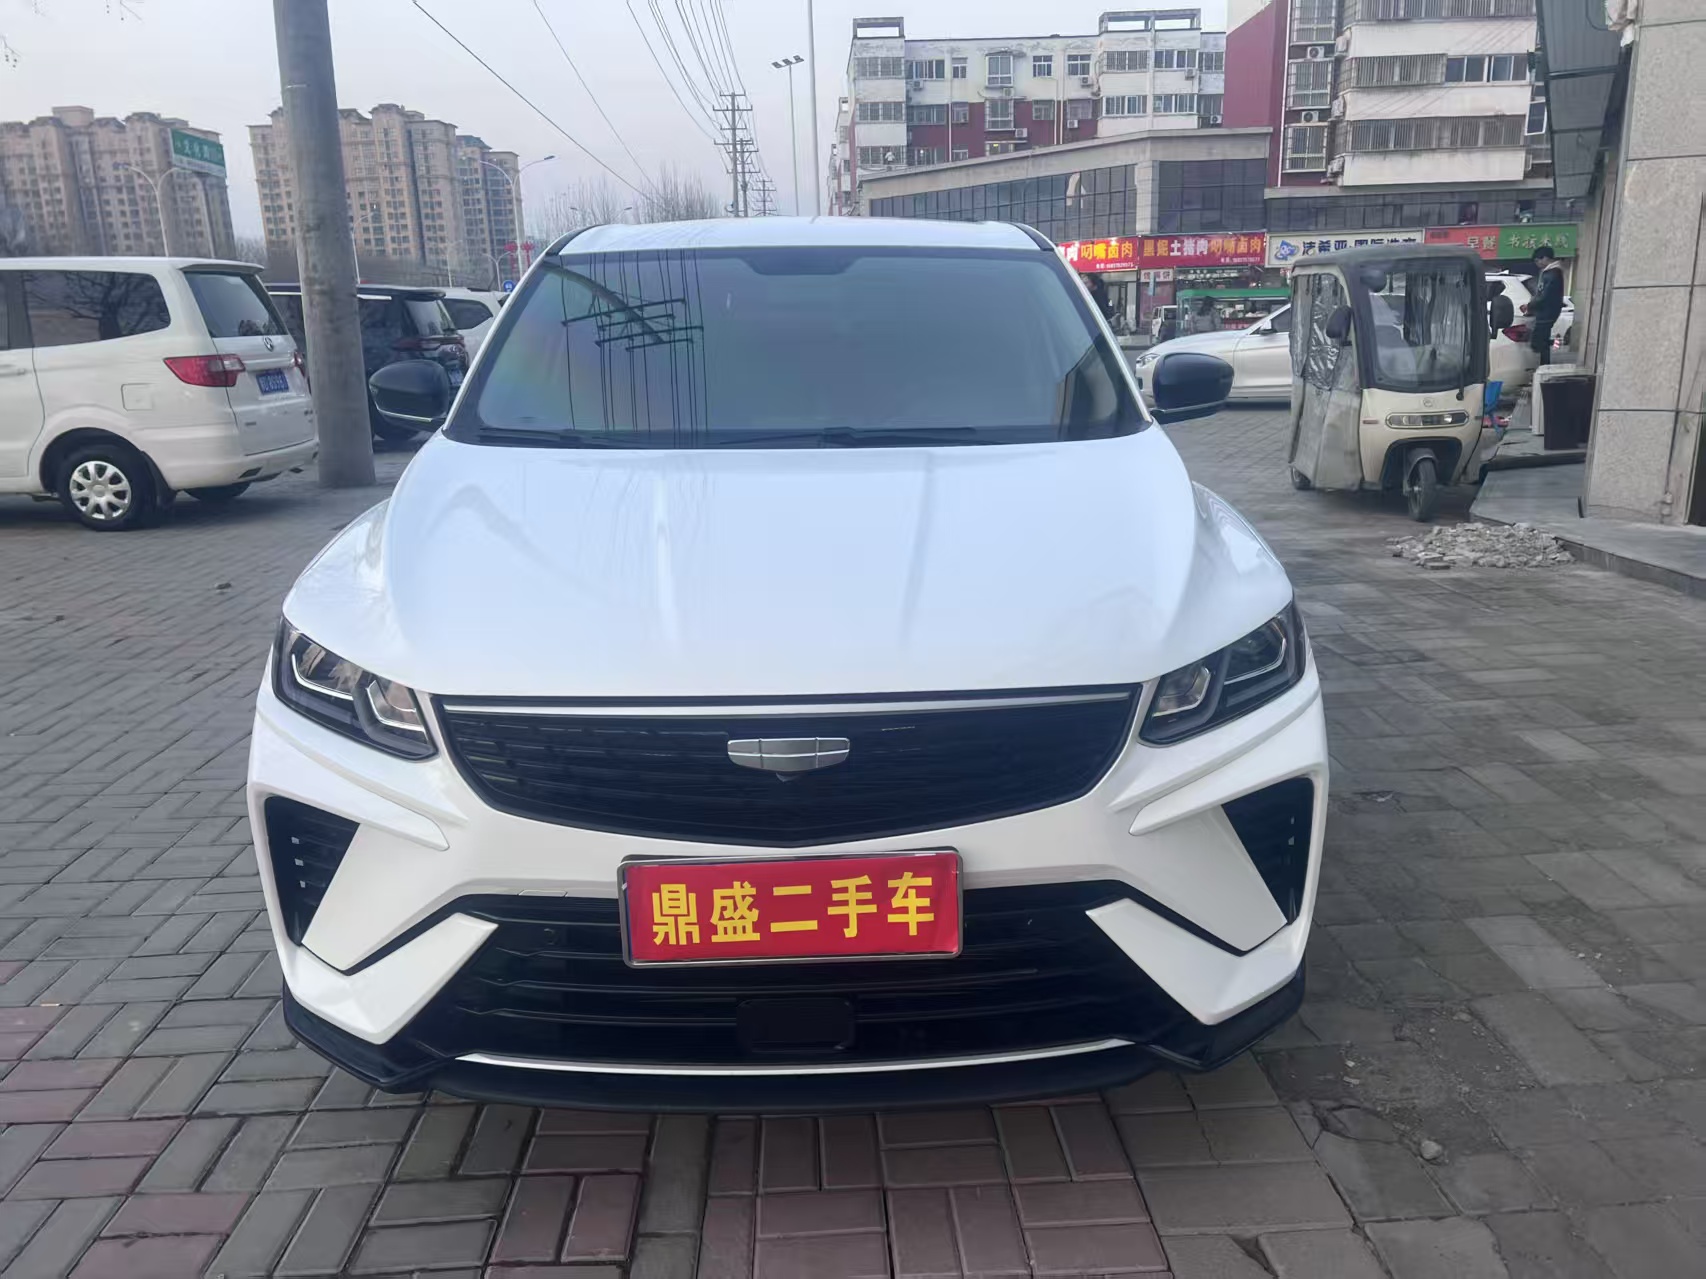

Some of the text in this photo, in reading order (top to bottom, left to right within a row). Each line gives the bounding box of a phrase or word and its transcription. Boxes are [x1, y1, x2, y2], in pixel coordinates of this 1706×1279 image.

[652, 871, 935, 945] 鼎盛二手车
